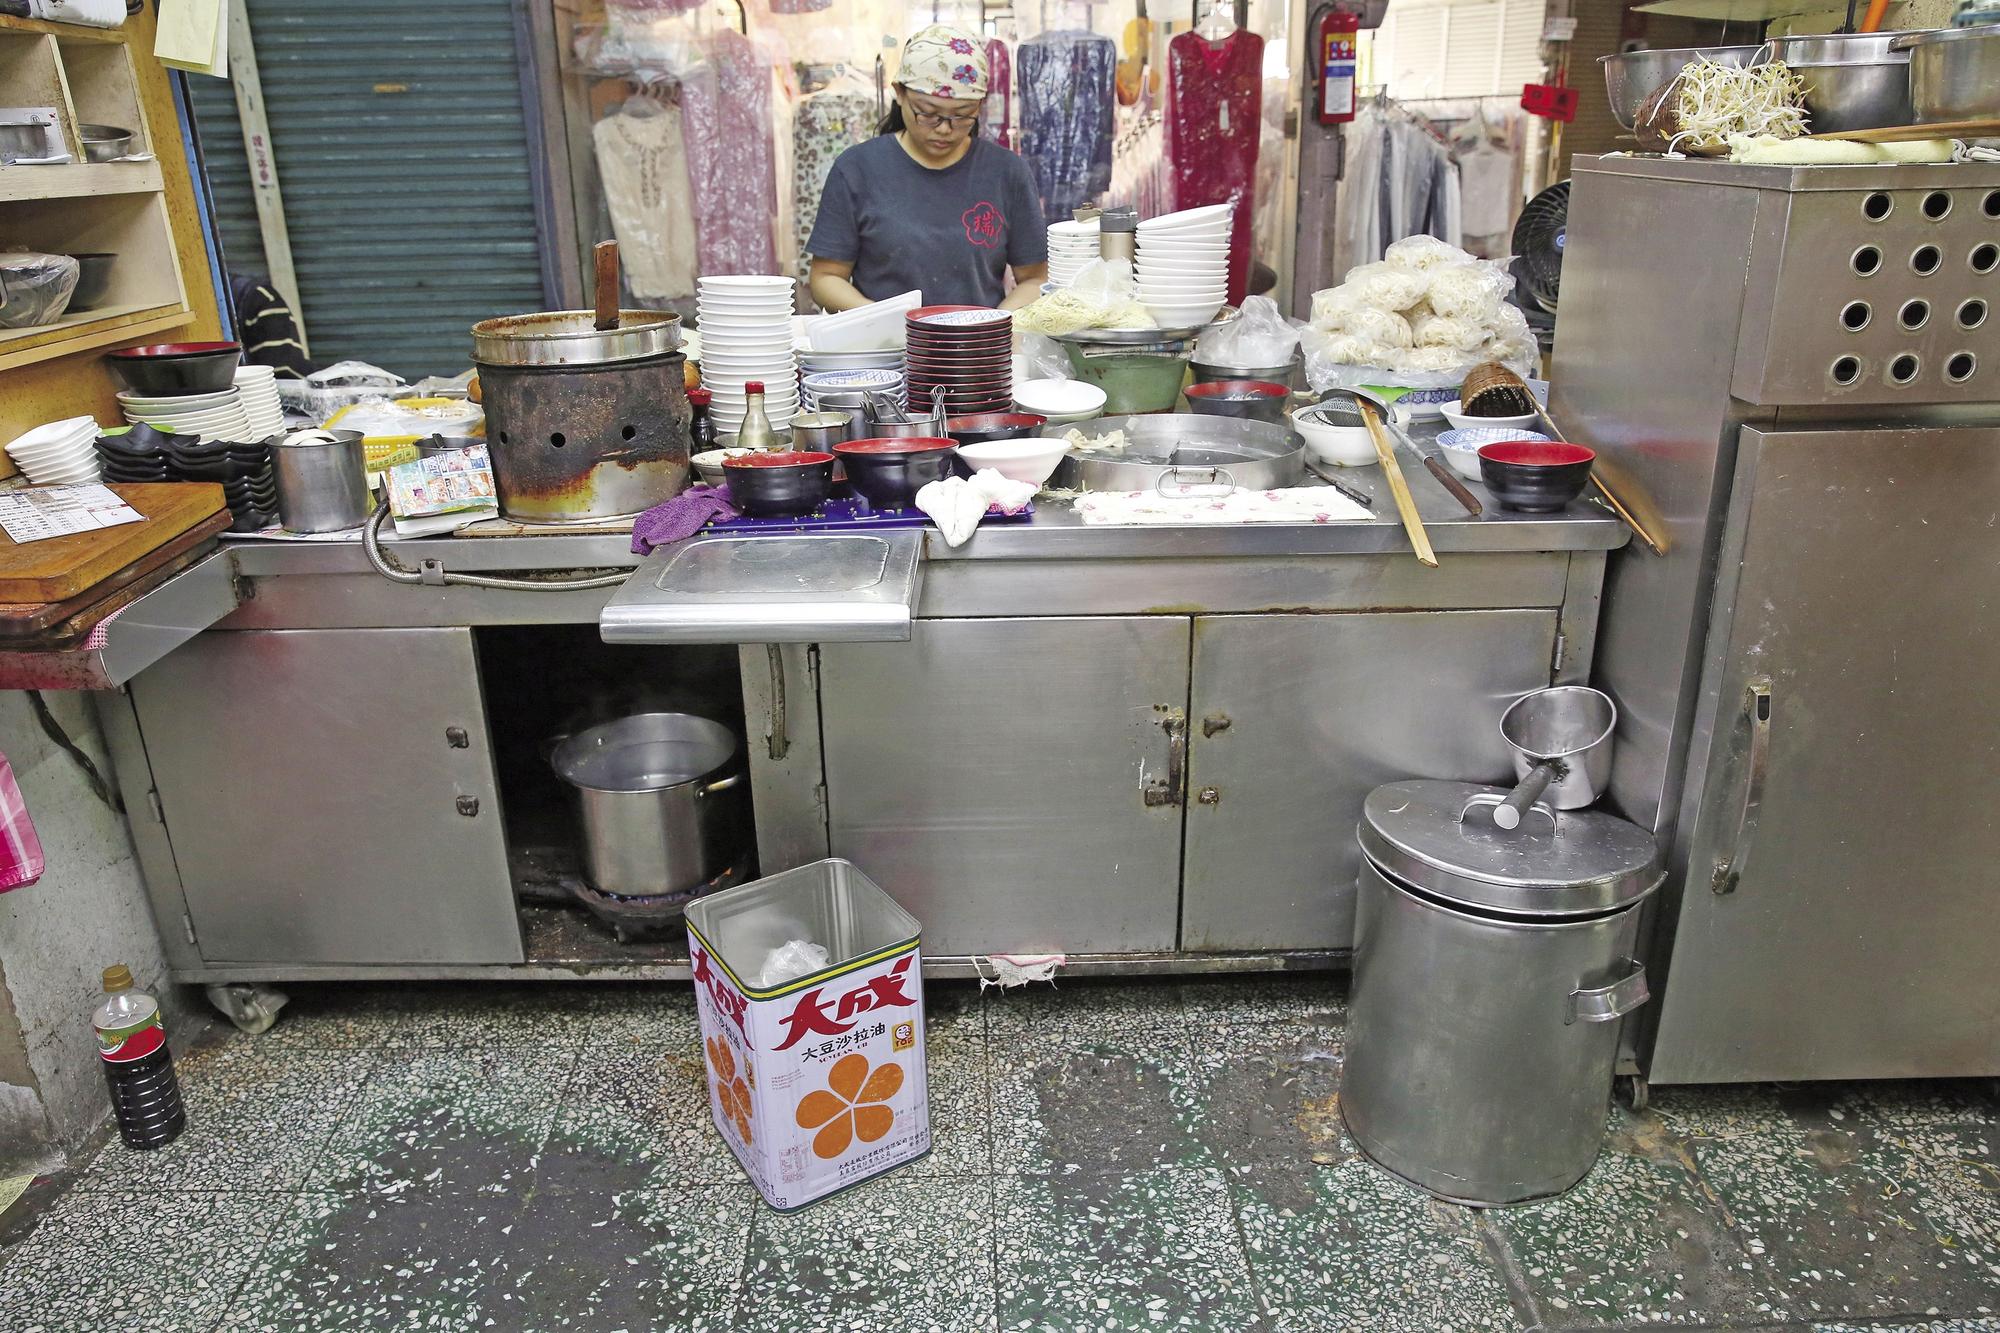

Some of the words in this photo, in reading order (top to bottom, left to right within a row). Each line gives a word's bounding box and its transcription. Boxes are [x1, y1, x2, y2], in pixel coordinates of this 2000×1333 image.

[770, 954, 918, 1051] 大成
[801, 1022, 886, 1062] 大豆沙拉油
